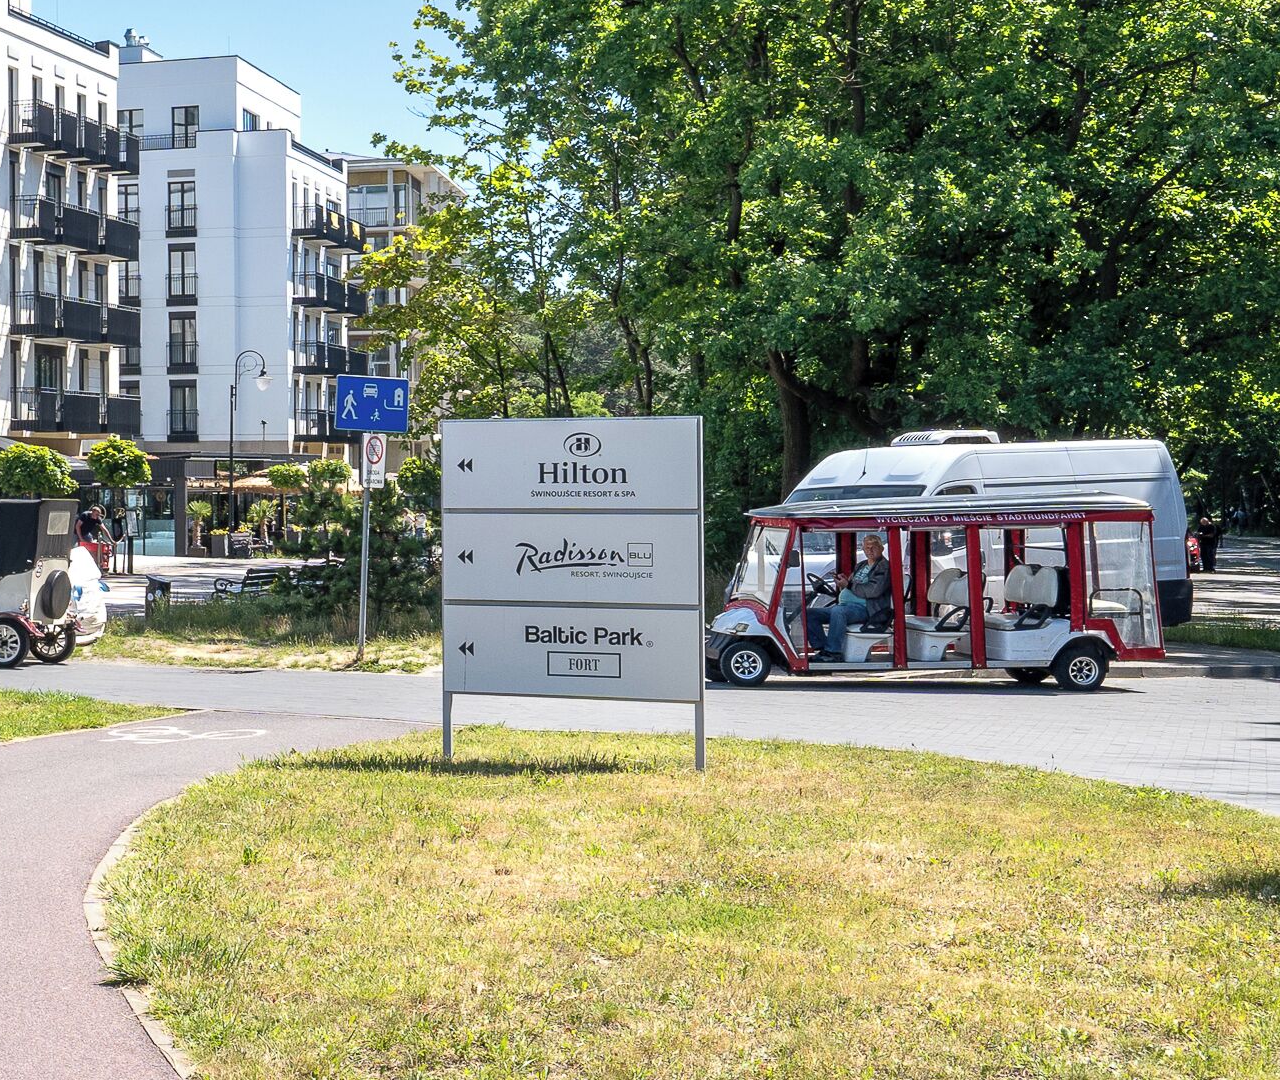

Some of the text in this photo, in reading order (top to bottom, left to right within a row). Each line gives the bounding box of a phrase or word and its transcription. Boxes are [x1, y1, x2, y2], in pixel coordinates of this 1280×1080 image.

[538, 461, 629, 485] Hilton
[530, 489, 636, 498] ŚWINOUJŚCIE RESORT & SPA
[876, 516, 930, 524] WYCIECZKI
[953, 513, 992, 522] MIEŚCIE
[996, 511, 1087, 521] STADTRUNDFAHRT
[515, 538, 625, 576] Radisson
[525, 625, 588, 645] Baltic
[568, 658, 601, 672] FORT
